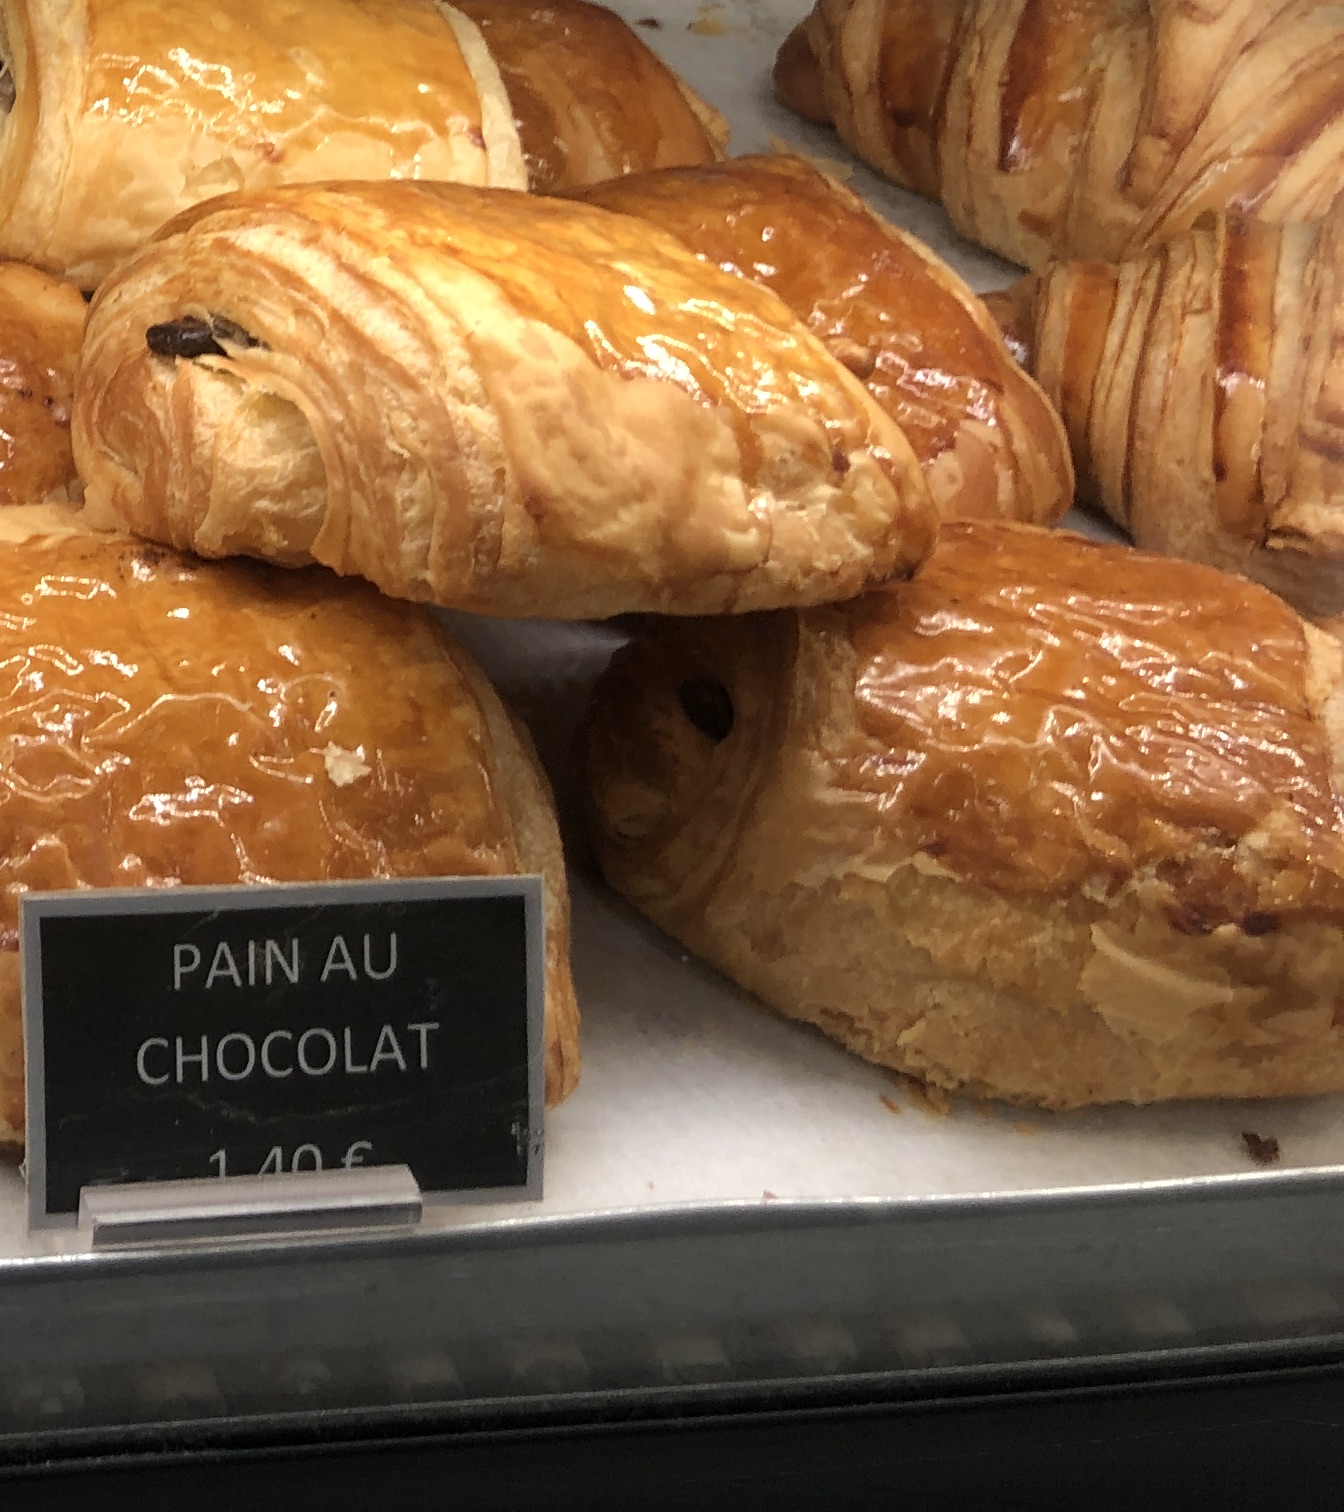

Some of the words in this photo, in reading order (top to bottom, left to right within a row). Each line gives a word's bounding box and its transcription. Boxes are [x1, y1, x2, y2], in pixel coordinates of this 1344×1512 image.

[172, 937, 300, 991] PAIN
[320, 932, 399, 981] AU
[135, 1021, 441, 1087] CHOCOLAT
[208, 1142, 322, 1179] 140
